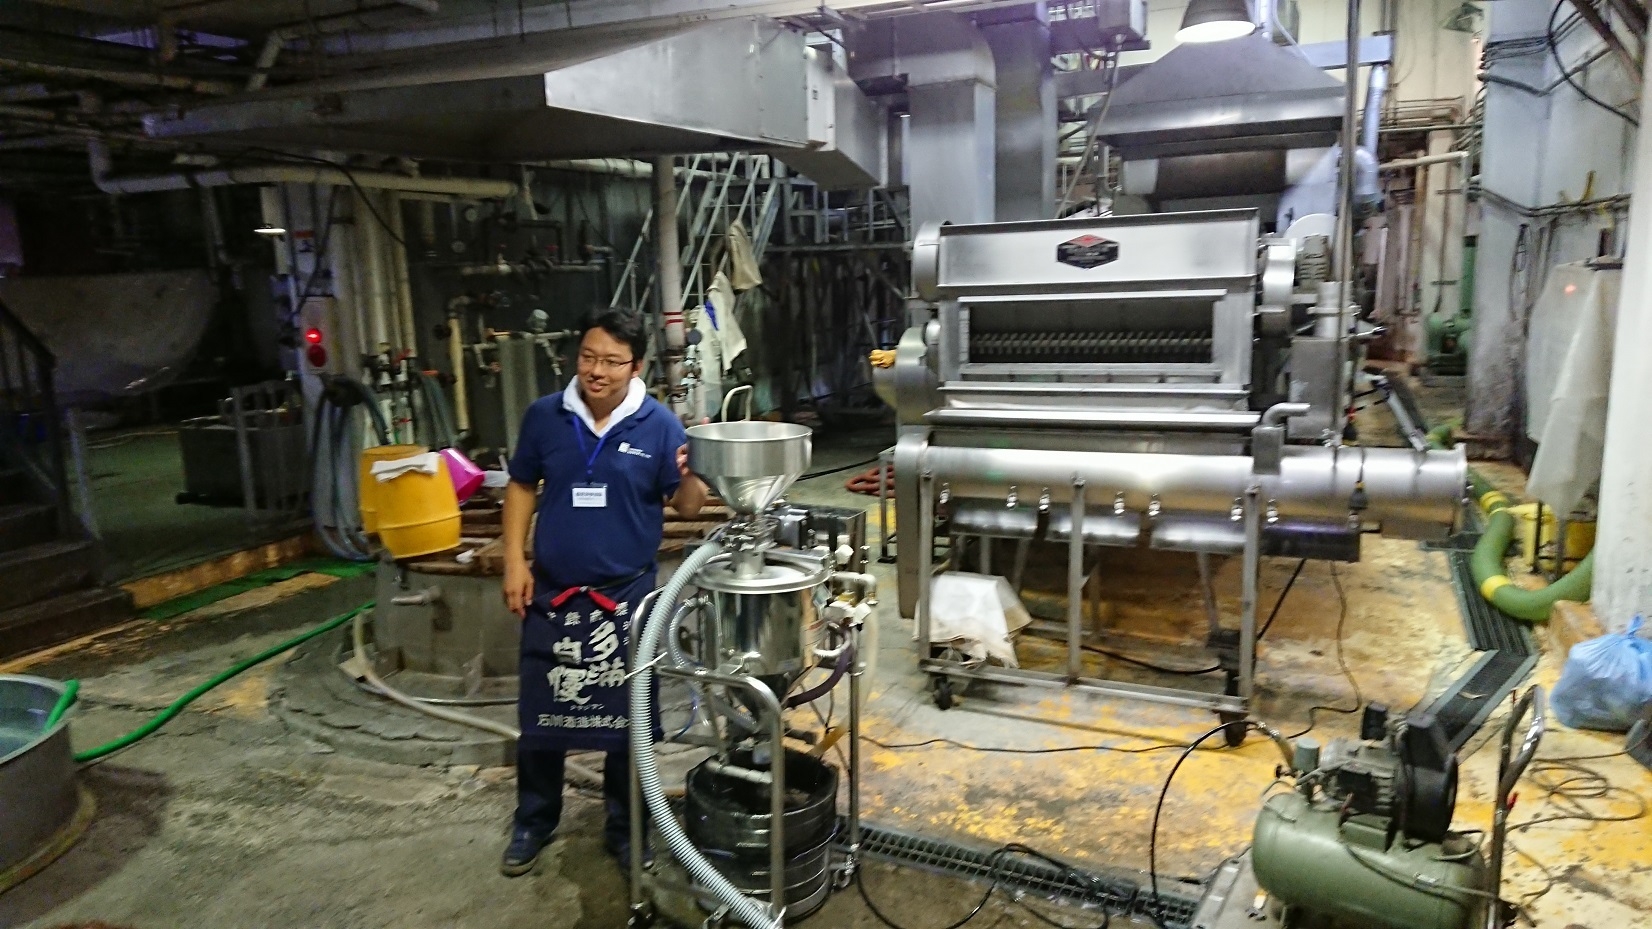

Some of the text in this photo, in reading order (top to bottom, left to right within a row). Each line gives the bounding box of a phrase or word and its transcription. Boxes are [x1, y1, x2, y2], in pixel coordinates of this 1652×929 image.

[537, 714, 631, 729] 石川酒造株式会
